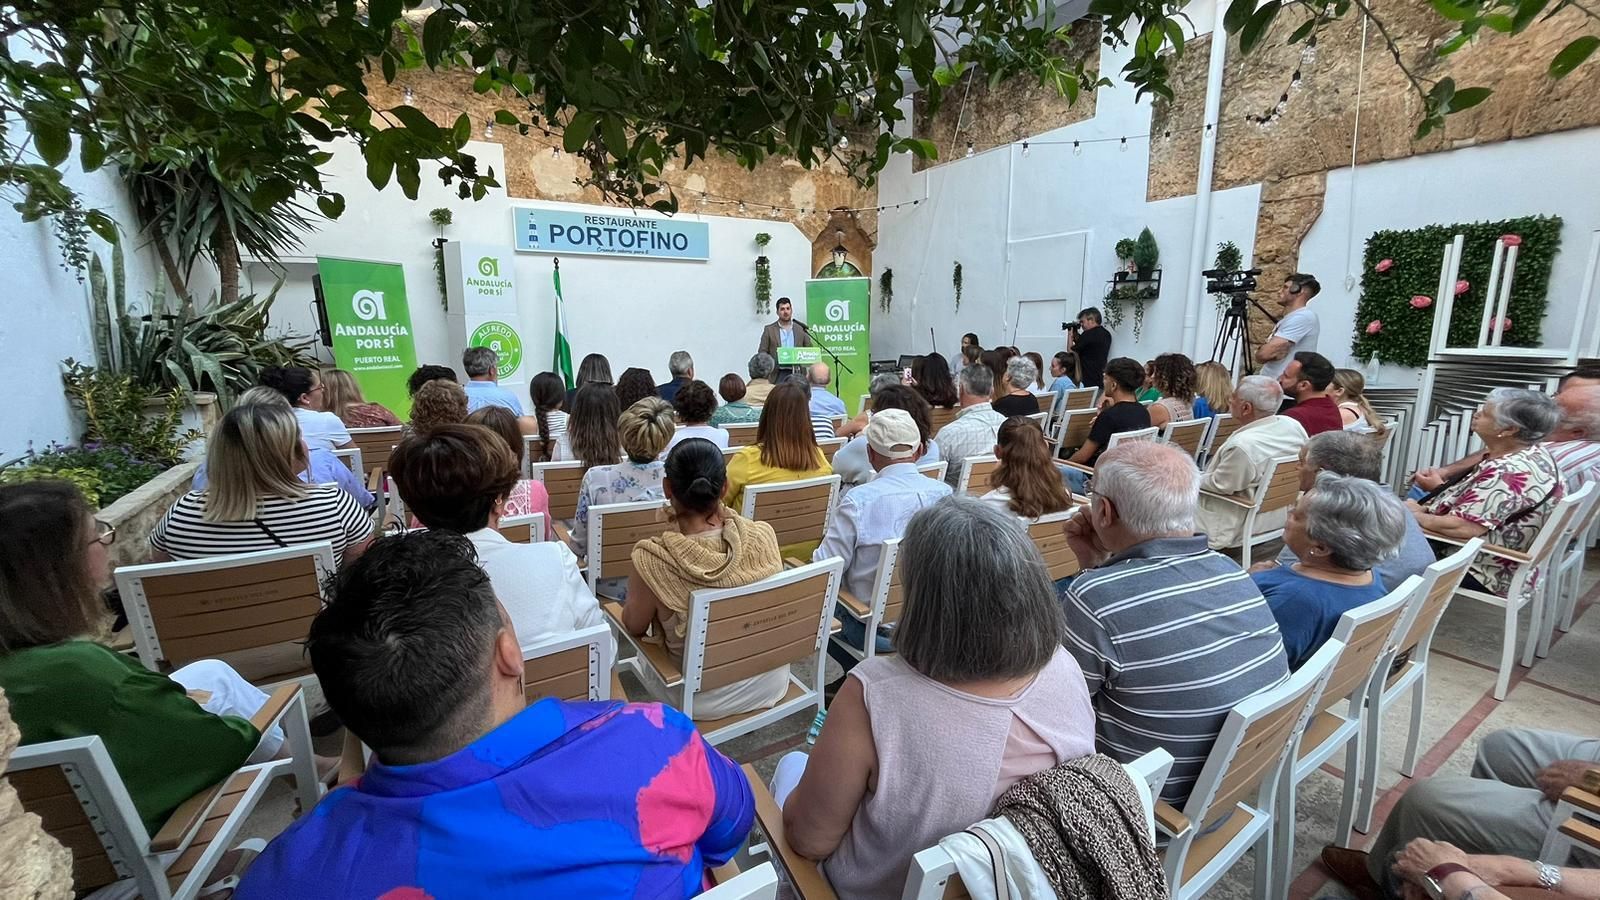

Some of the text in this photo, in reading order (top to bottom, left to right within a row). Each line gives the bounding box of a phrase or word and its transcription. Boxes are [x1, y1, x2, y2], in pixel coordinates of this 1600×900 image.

[585, 216, 657, 229] RESTAURANTE
[549, 224, 688, 251] PORTOFINO
[467, 277, 513, 288] ANDALUCÍA
[496, 287, 503, 296] SÍ
[335, 322, 408, 336] ANDALUCÍA
[479, 325, 512, 338] ALFREDO
[812, 321, 866, 333] ANDALUCÍA
[356, 335, 395, 349] POR SÍ
[824, 331, 853, 342] POR SÍ
[354, 356, 383, 364] PUERTO
